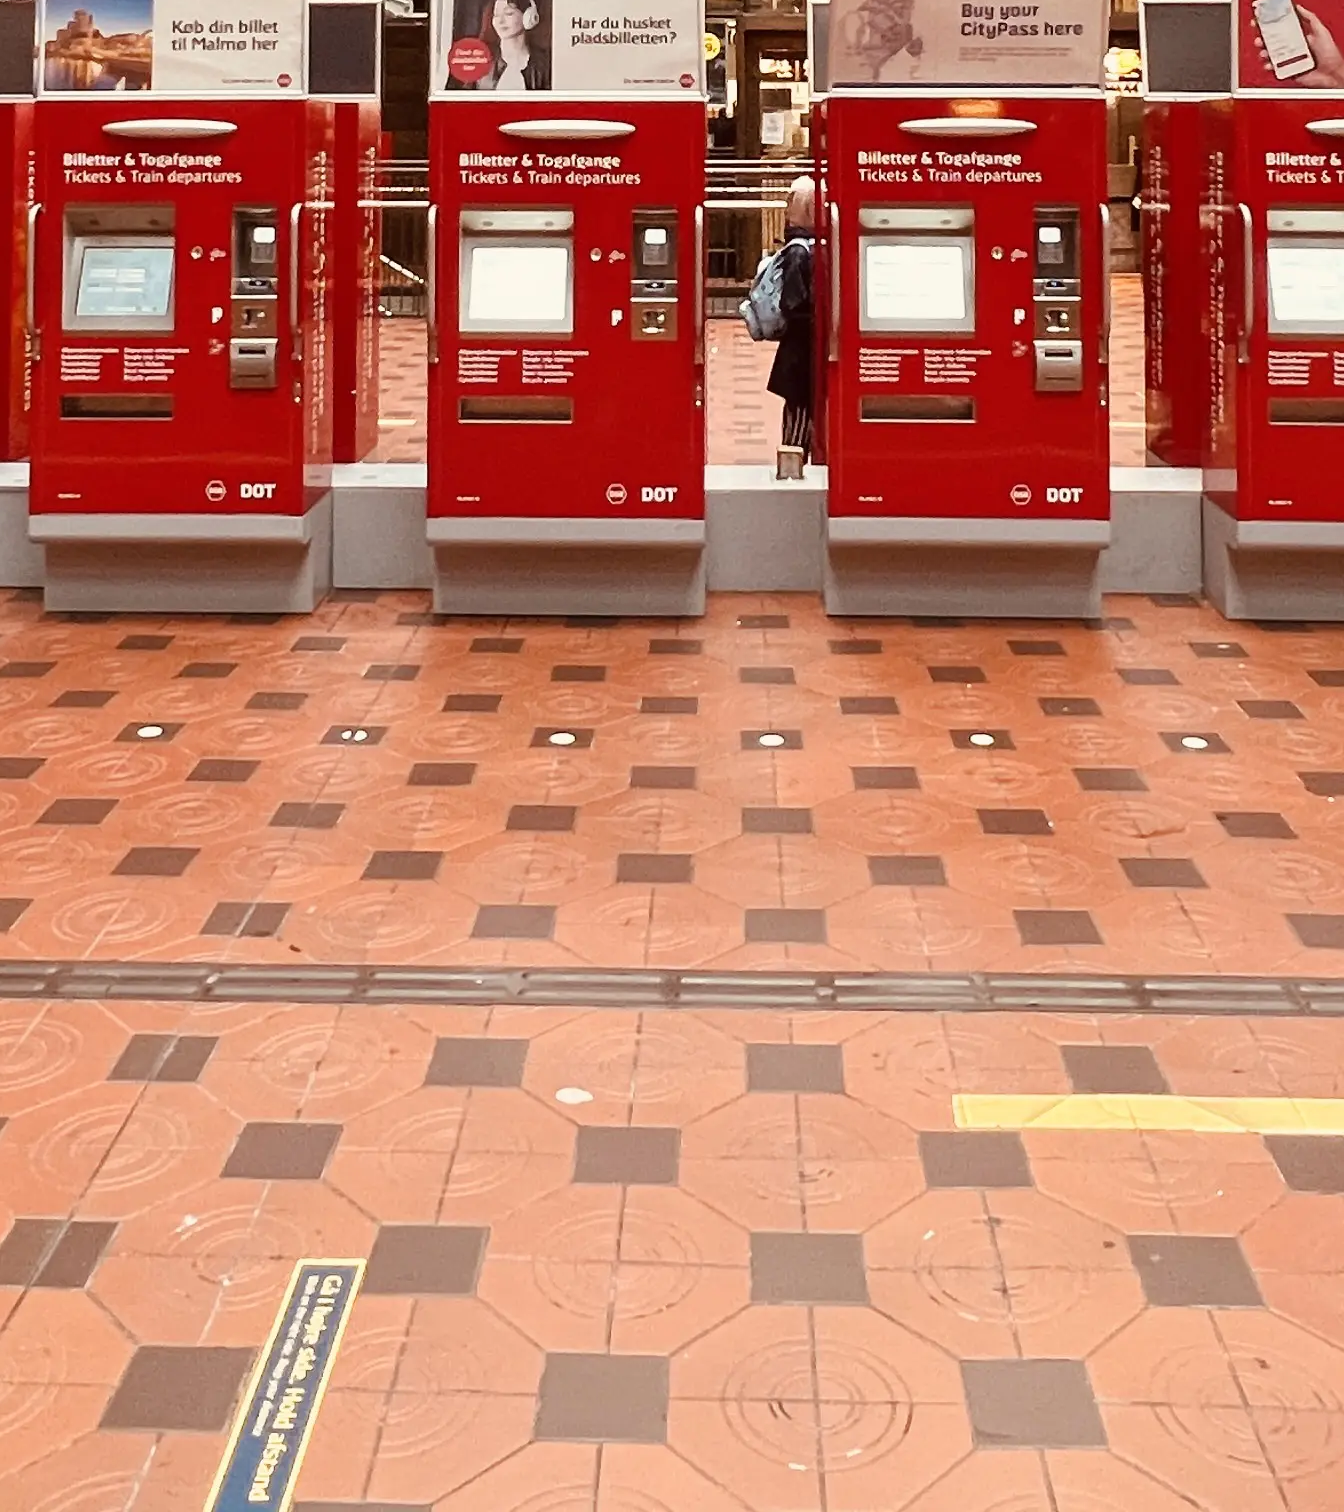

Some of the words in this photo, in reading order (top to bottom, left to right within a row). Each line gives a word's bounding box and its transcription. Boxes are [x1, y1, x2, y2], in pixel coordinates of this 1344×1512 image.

[962, 4, 994, 20] Buy
[1000, 6, 1039, 20] your
[173, 20, 204, 33] Køb
[209, 20, 233, 33] din
[239, 20, 278, 33] billet
[572, 17, 596, 28] Har
[601, 17, 619, 28] du
[624, 17, 671, 29] husket
[961, 22, 1038, 39] CityPass
[1044, 22, 1082, 35] here
[172, 38, 186, 50] til
[192, 37, 246, 50] Malmø
[252, 37, 278, 50] her
[572, 32, 676, 46] pladsbilletten?
[63, 153, 121, 166] Billetter
[125, 153, 135, 165] &
[459, 153, 518, 167] Billetter
[522, 154, 532, 166] &
[858, 151, 917, 165] Billetter
[921, 152, 932, 164] &
[1266, 152, 1326, 166] Billetter
[1330, 153, 1341, 166] &
[64, 170, 111, 183] Tickets
[115, 170, 126, 183] &
[131, 170, 164, 183] Train
[167, 171, 242, 185] departures
[460, 171, 508, 184] Tickets
[513, 171, 523, 183] &
[528, 171, 561, 184] Train
[565, 171, 640, 186] departures
[859, 169, 908, 182] Tickets
[912, 169, 922, 182] &
[927, 168, 961, 182] Train
[966, 169, 1042, 184] departures
[1267, 170, 1316, 183] Tickets
[1321, 170, 1331, 183] &
[241, 484, 276, 498] DOT
[642, 487, 677, 502] DOT
[1047, 488, 1083, 502] DOT
[273, 1388, 305, 1429] Hold
[248, 1433, 288, 1501] afstand
